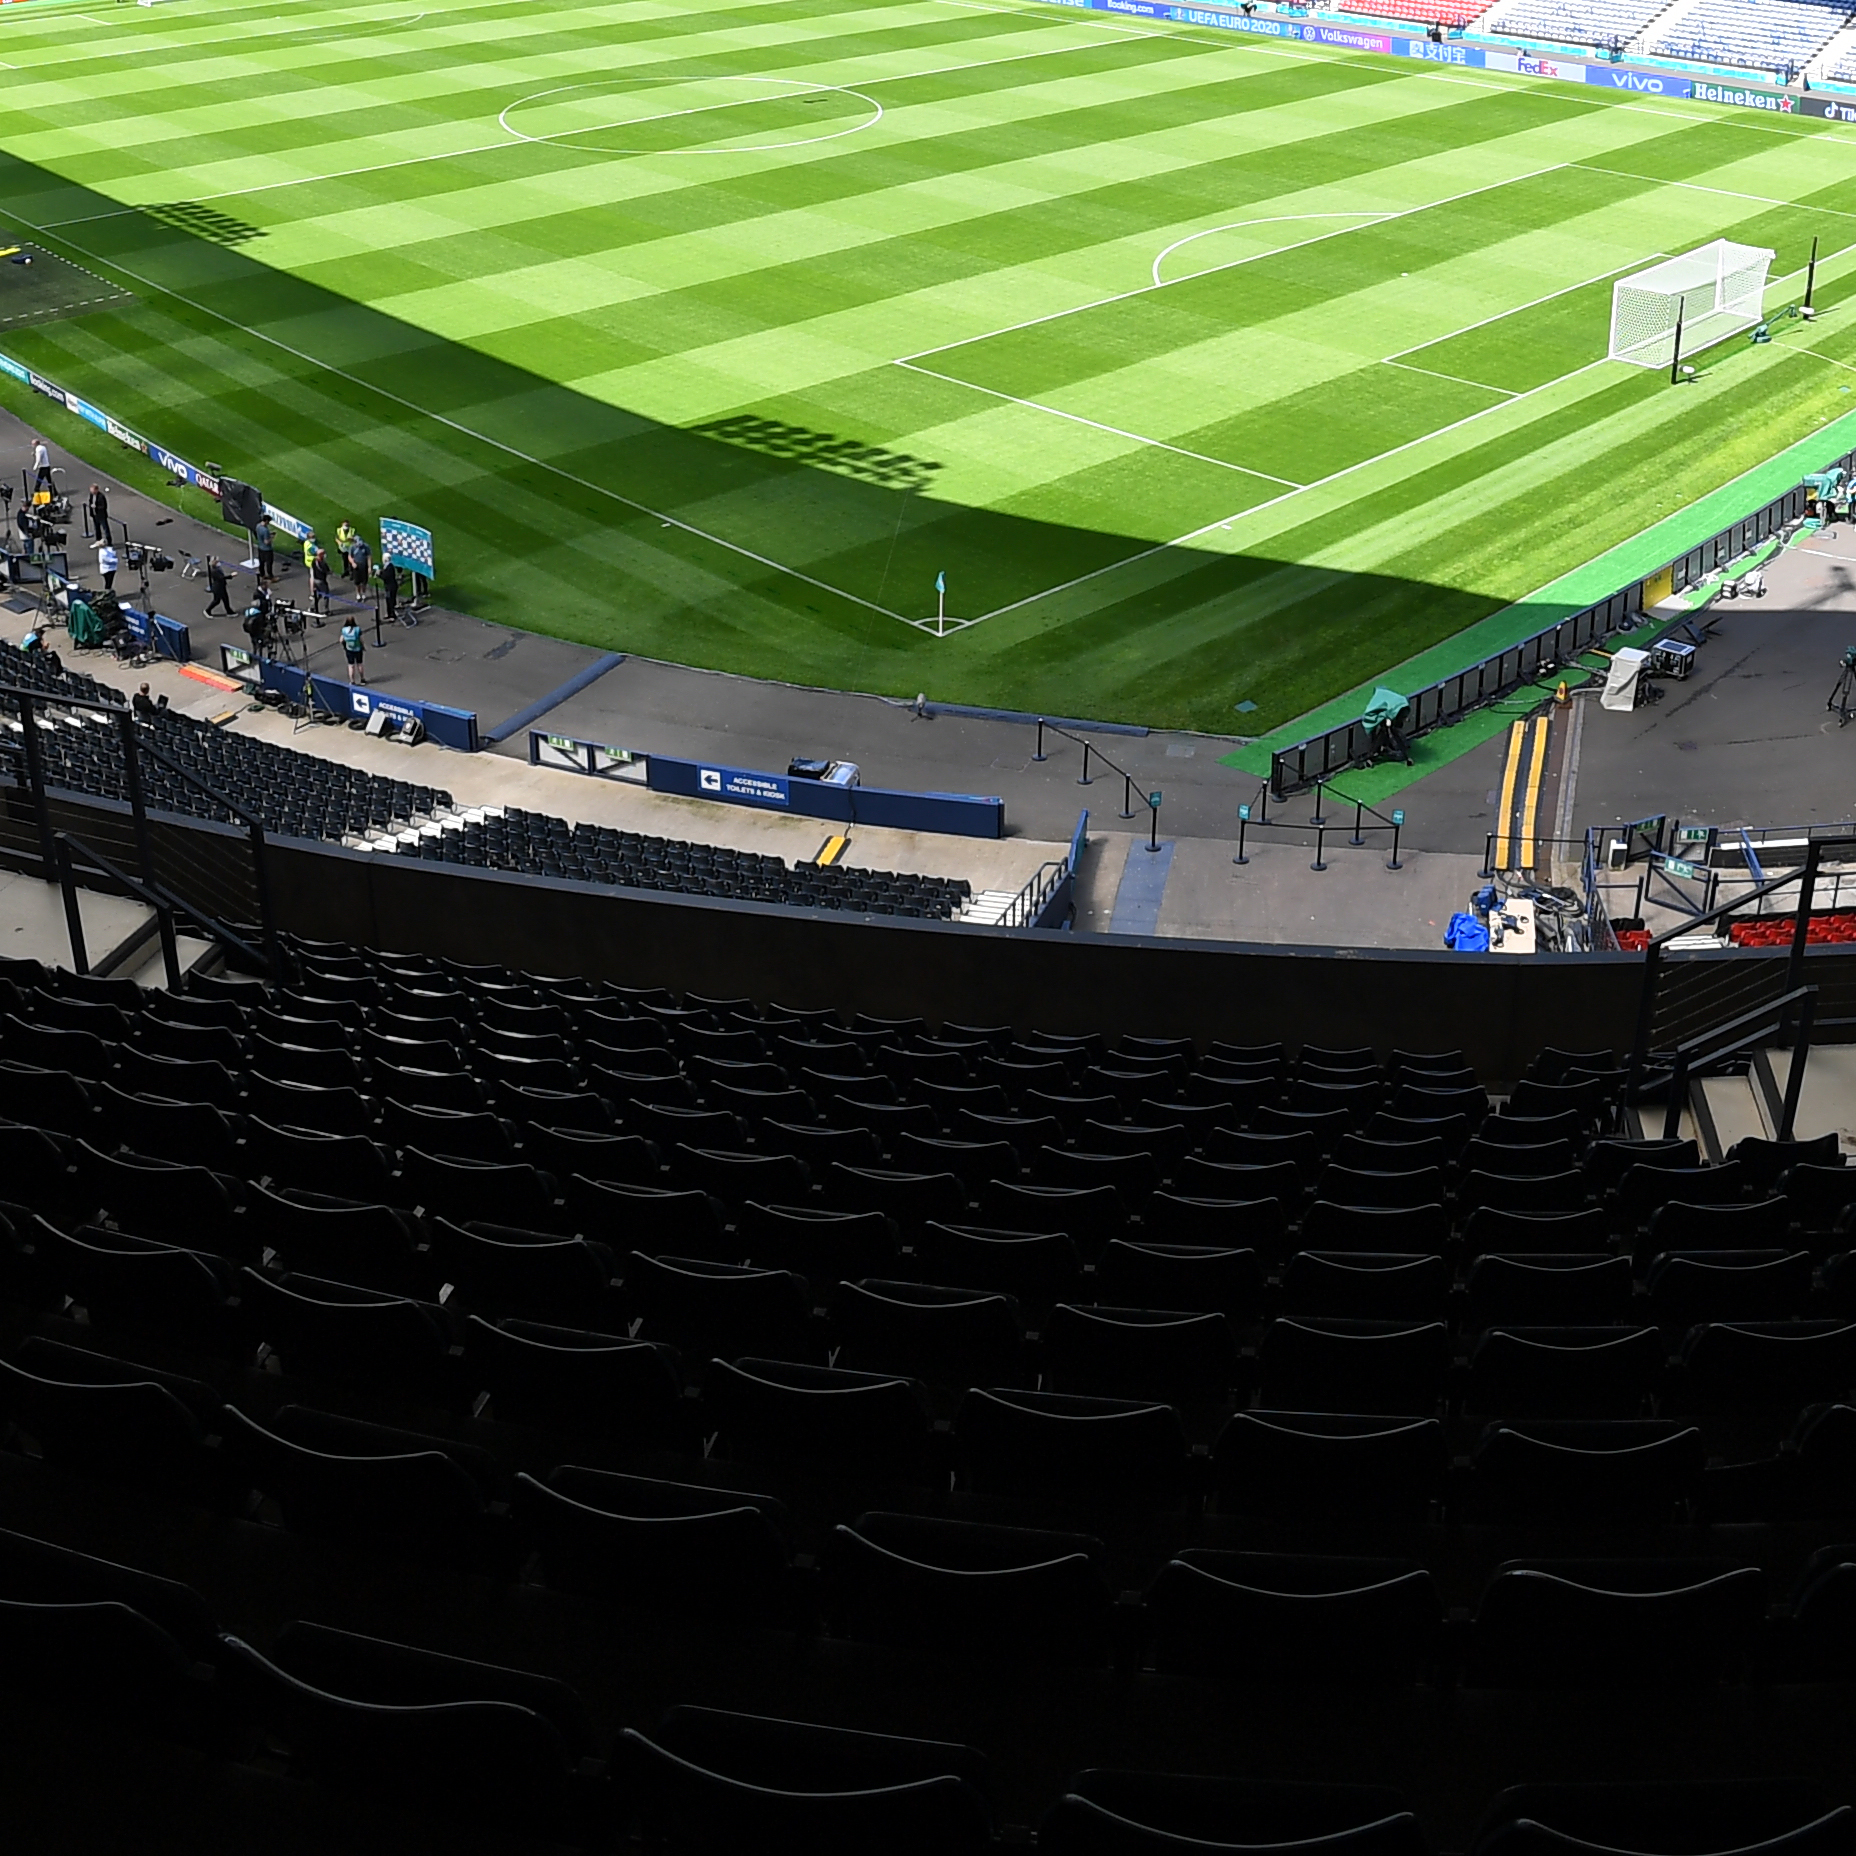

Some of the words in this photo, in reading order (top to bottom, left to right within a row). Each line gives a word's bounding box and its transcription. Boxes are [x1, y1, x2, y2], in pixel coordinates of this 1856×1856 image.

[1188, 10, 1218, 27] UEFA
[1218, 14, 1251, 31] EURO
[1251, 19, 1280, 35] 2020
[1320, 28, 1383, 50] Volkswagen
[1425, 43, 1466, 63] 支付宝
[1517, 56, 1558, 78] FedEx
[1611, 72, 1663, 94] vivo
[1694, 83, 1777, 110] Heineken
[726, 783, 755, 796] TOILETS
[762, 787, 786, 800] KIOSK
[733, 776, 778, 791] ACCESSIBLE
